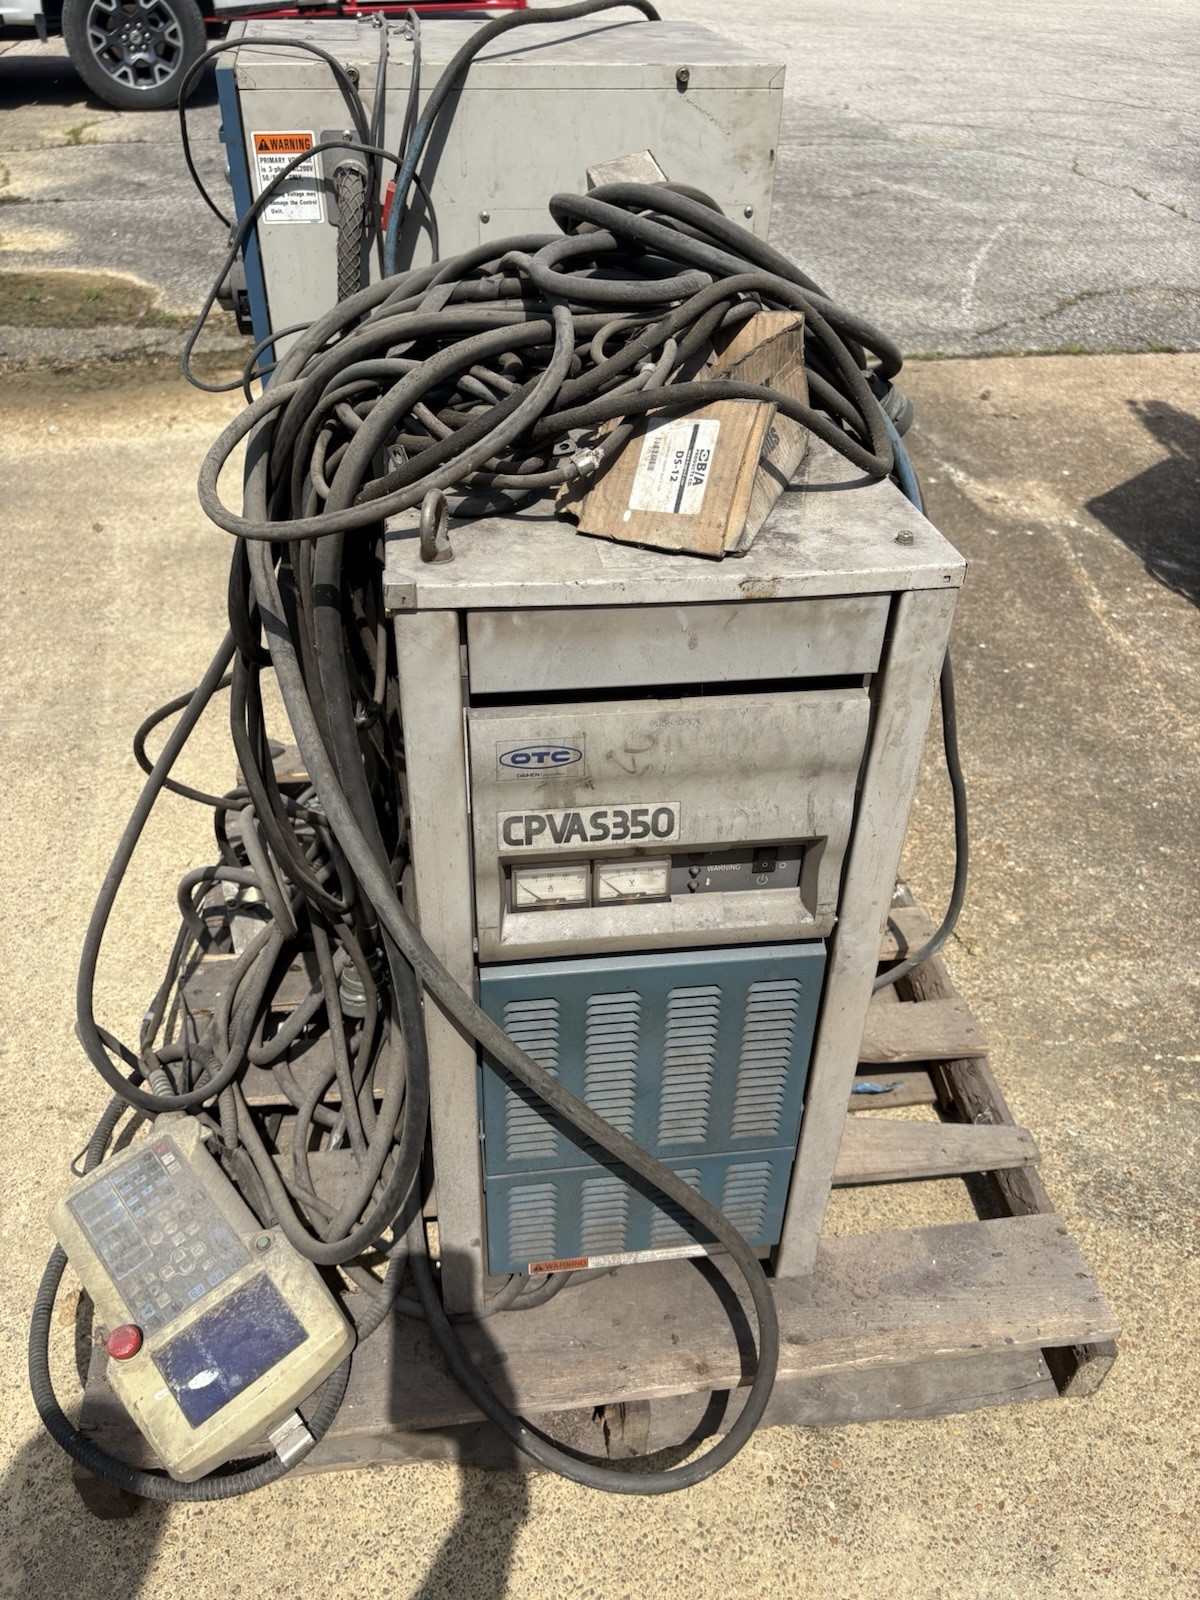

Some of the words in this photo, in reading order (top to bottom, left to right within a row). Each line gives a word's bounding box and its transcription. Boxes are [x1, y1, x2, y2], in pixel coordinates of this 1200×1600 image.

[270, 138, 310, 150] WARNING
[300, 198, 317, 206] Control
[669, 450, 684, 482] DS-12
[691, 449, 700, 478] PRODUCTS
[510, 750, 571, 765] OTC
[502, 806, 675, 847] CPVAS350
[706, 863, 742, 872] WARNING
[545, 1259, 587, 1270] WARNING
